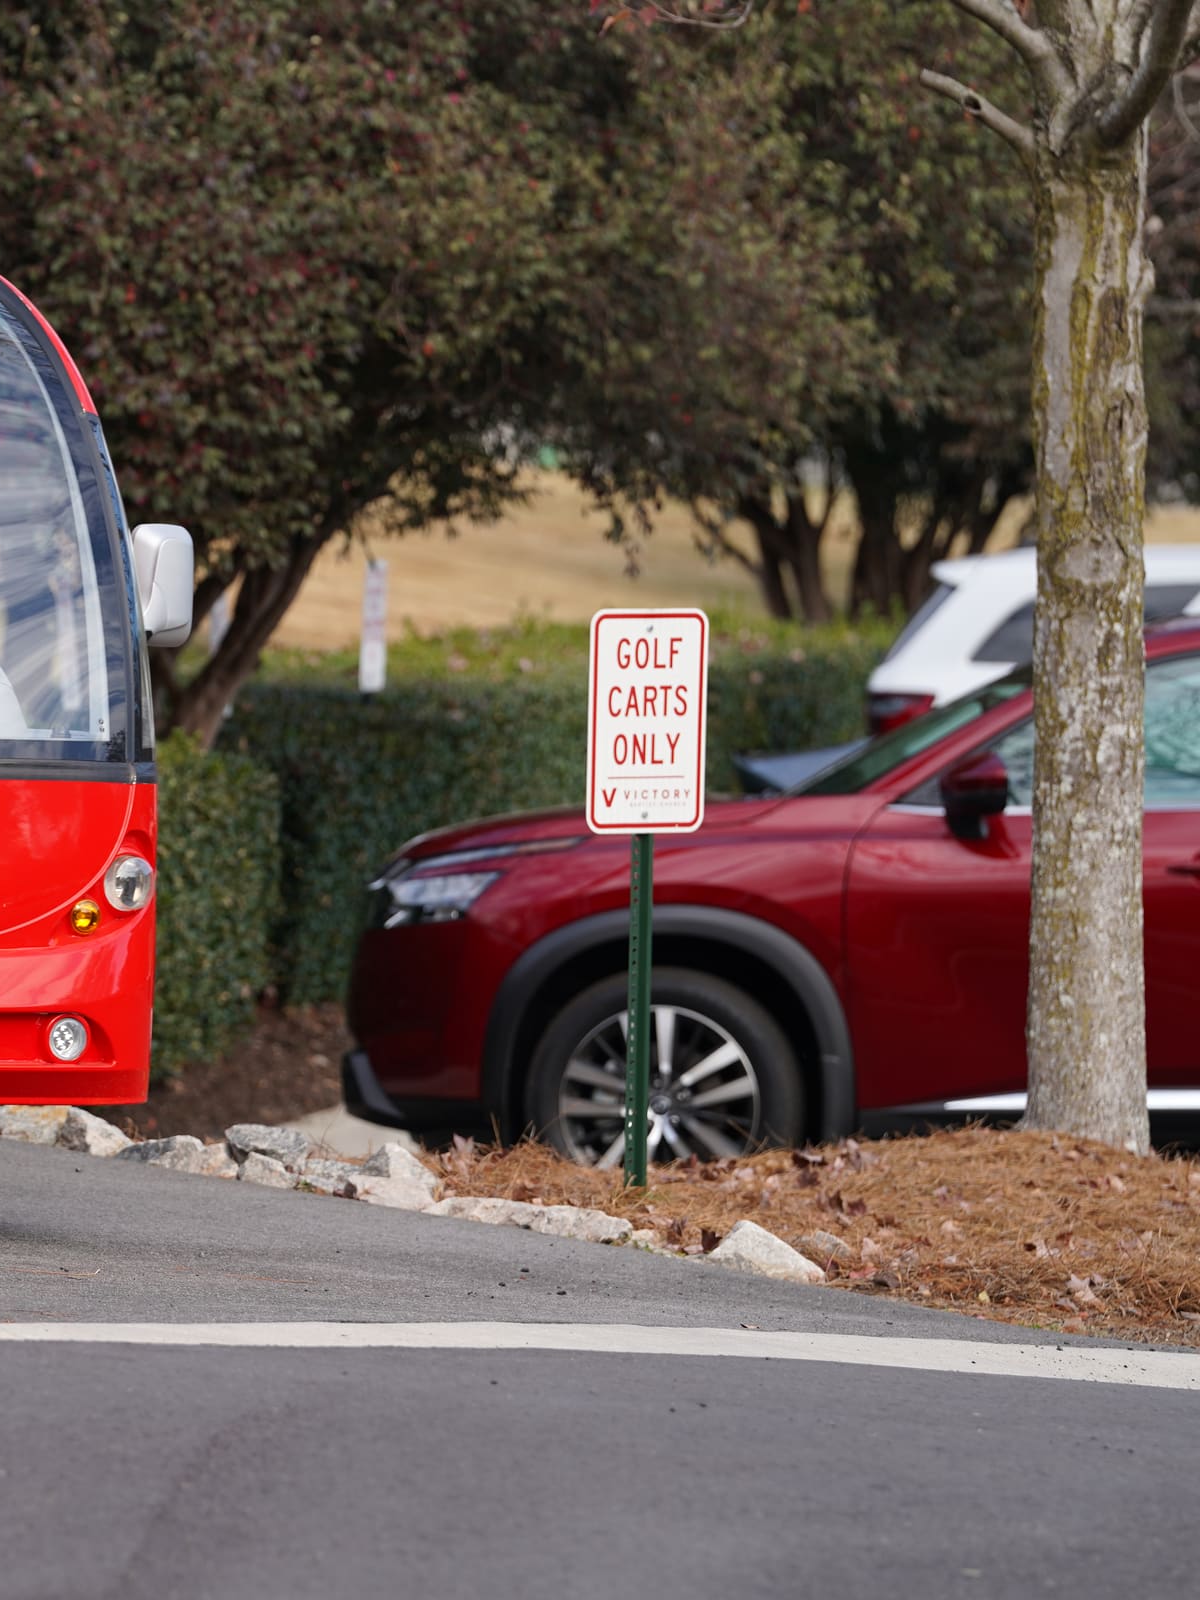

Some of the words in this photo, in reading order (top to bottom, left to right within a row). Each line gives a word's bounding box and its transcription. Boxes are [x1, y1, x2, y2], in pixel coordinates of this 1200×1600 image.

[617, 637, 683, 669] GOLF
[608, 685, 687, 717] CARTS
[613, 733, 680, 765] ONLY
[624, 789, 690, 800] VICTORY
